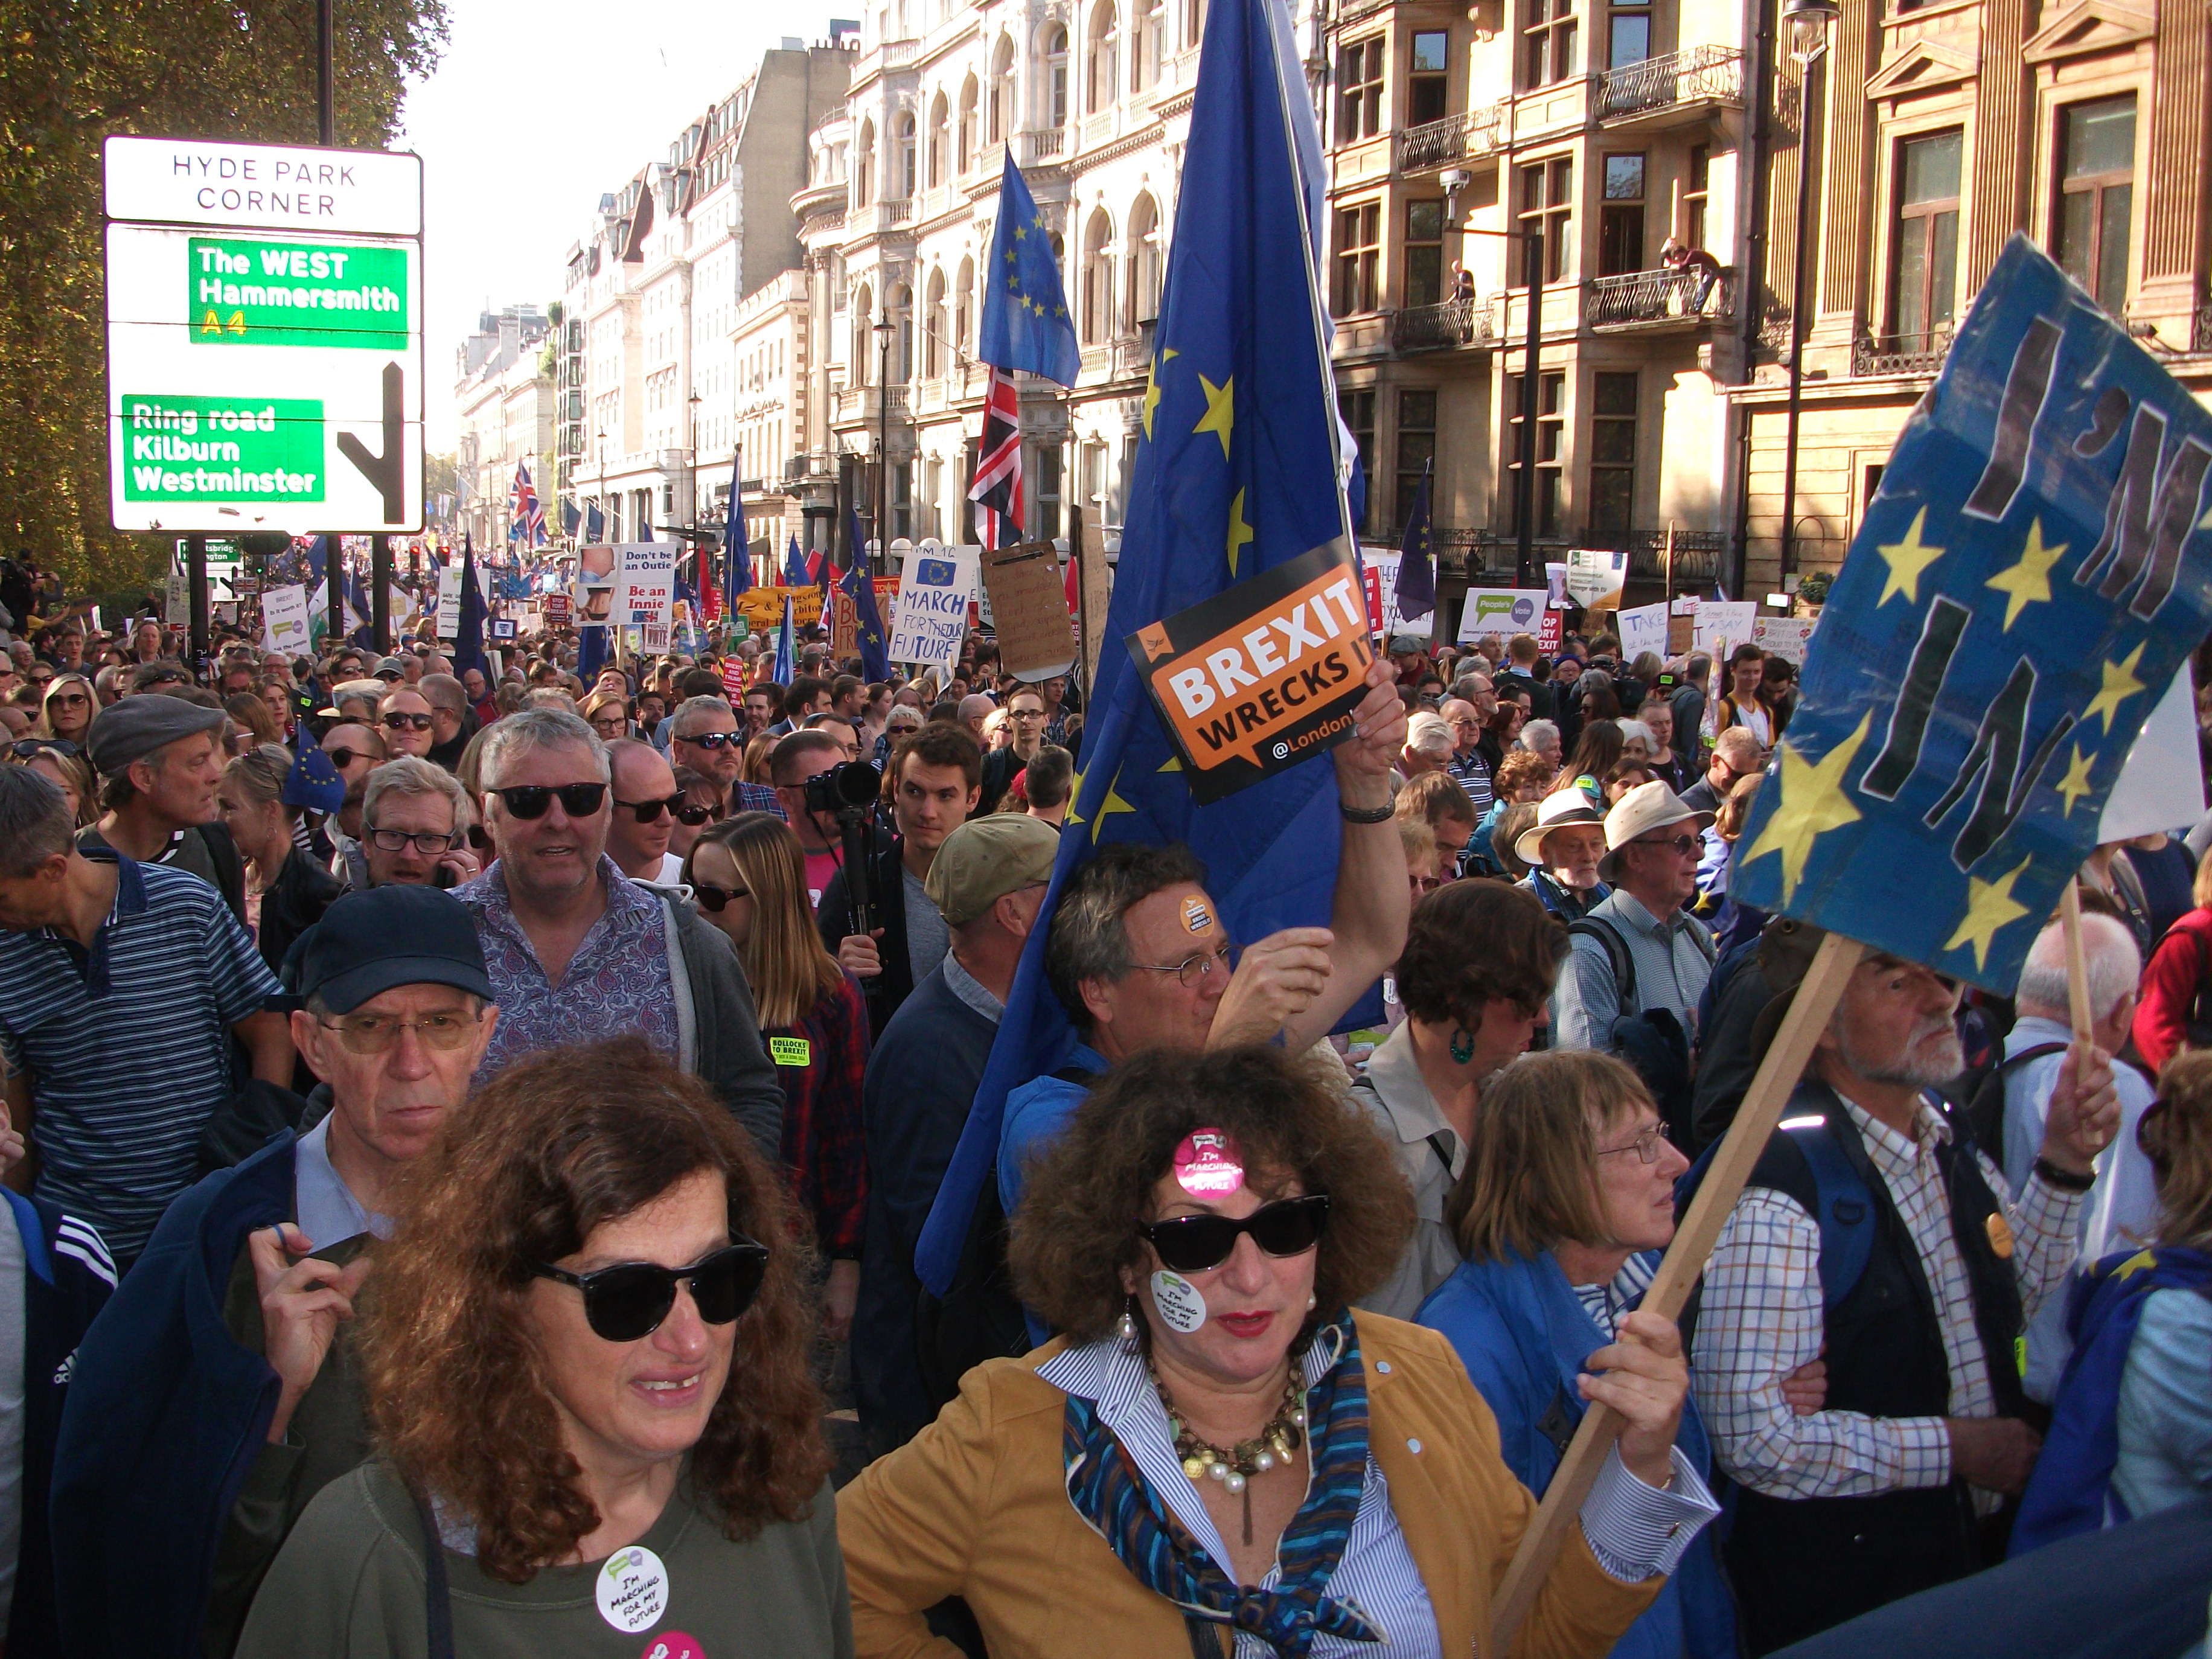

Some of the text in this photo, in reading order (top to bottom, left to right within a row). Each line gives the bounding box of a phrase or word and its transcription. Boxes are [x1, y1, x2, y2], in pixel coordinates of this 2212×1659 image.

[173, 155, 356, 187] HYDE PARK
[197, 188, 335, 216] CORNER
[198, 248, 348, 280] The WEST
[199, 278, 400, 312] Hammersmith
[202, 310, 246, 336] A4
[133, 403, 275, 434] Ring road
[133, 435, 240, 462] Kilburn
[133, 466, 317, 494] Westminster
[626, 552, 656, 560] Don't
[642, 561, 672, 570] Outie
[628, 586, 645, 596] Be
[777, 592, 821, 603] Kngston
[904, 590, 965, 615] MARCH
[628, 599, 665, 609] Innie
[764, 602, 772, 611] &
[1480, 600, 1510, 610] People's
[904, 615, 926, 630] FOR
[1542, 618, 1557, 627] OP
[1625, 613, 1666, 633] TAKE
[892, 634, 956, 660] FUTURE
[1169, 578, 1360, 719] BREXIT
[1538, 640, 1558, 650] EXIT
[1197, 651, 1350, 751] WRECKS
[1273, 709, 1354, 759] @London
[1857, 594, 2076, 873] IN
[773, 1040, 806, 1049] BOLLOCKS
[1185, 1162, 1236, 1171] MARCHING
[1201, 1152, 1218, 1161] I'M
[1157, 1291, 1198, 1315] MARCHING
[1168, 1290, 1181, 1302] I'M
[1178, 1312, 1191, 1321] MY
[611, 1576, 660, 1611] MARCHING
[622, 1574, 639, 1590] I'M
[623, 1590, 656, 1617] FOR MY
[628, 1601, 661, 1628] FUTURE
